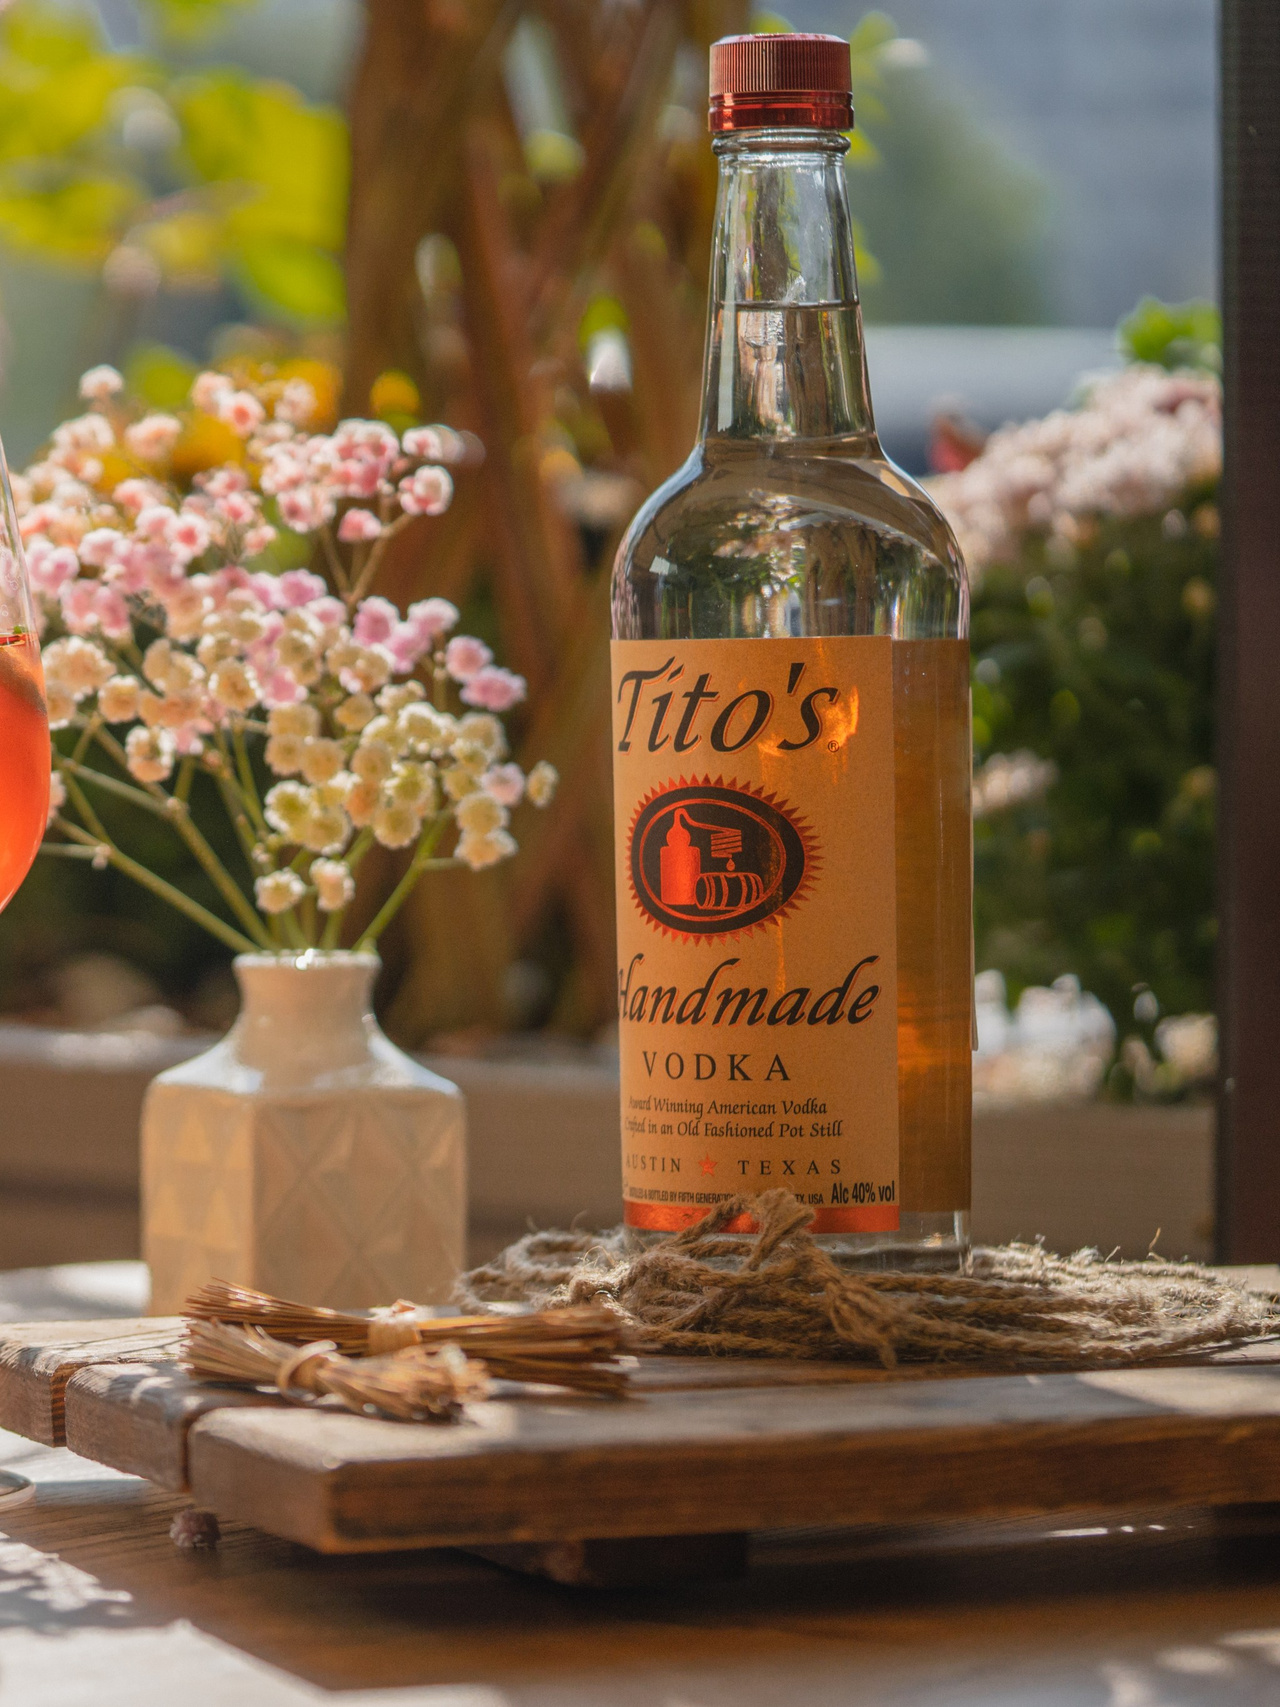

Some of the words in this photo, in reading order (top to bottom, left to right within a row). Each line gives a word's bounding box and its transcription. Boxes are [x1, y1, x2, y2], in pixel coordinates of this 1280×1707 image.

[618, 656, 839, 754] Tito's
[619, 953, 881, 1027] Handmade
[642, 1051, 791, 1081] VODKA
[653, 1097, 704, 1120] Winning
[707, 1100, 776, 1115] American
[782, 1098, 828, 1115] Vodka
[648, 1120, 658, 1134] in
[660, 1123, 674, 1135] an
[677, 1120, 701, 1136] Old
[704, 1121, 775, 1138] Fashioned
[779, 1123, 805, 1138] Pot
[809, 1120, 844, 1137] Still
[625, 1154, 681, 1172] AUSTIN
[737, 1159, 841, 1175] TEXAS
[808, 1193, 824, 1204] USA
[830, 1182, 849, 1204] Alc
[851, 1182, 876, 1203] 40%
[878, 1180, 895, 1202] vol
